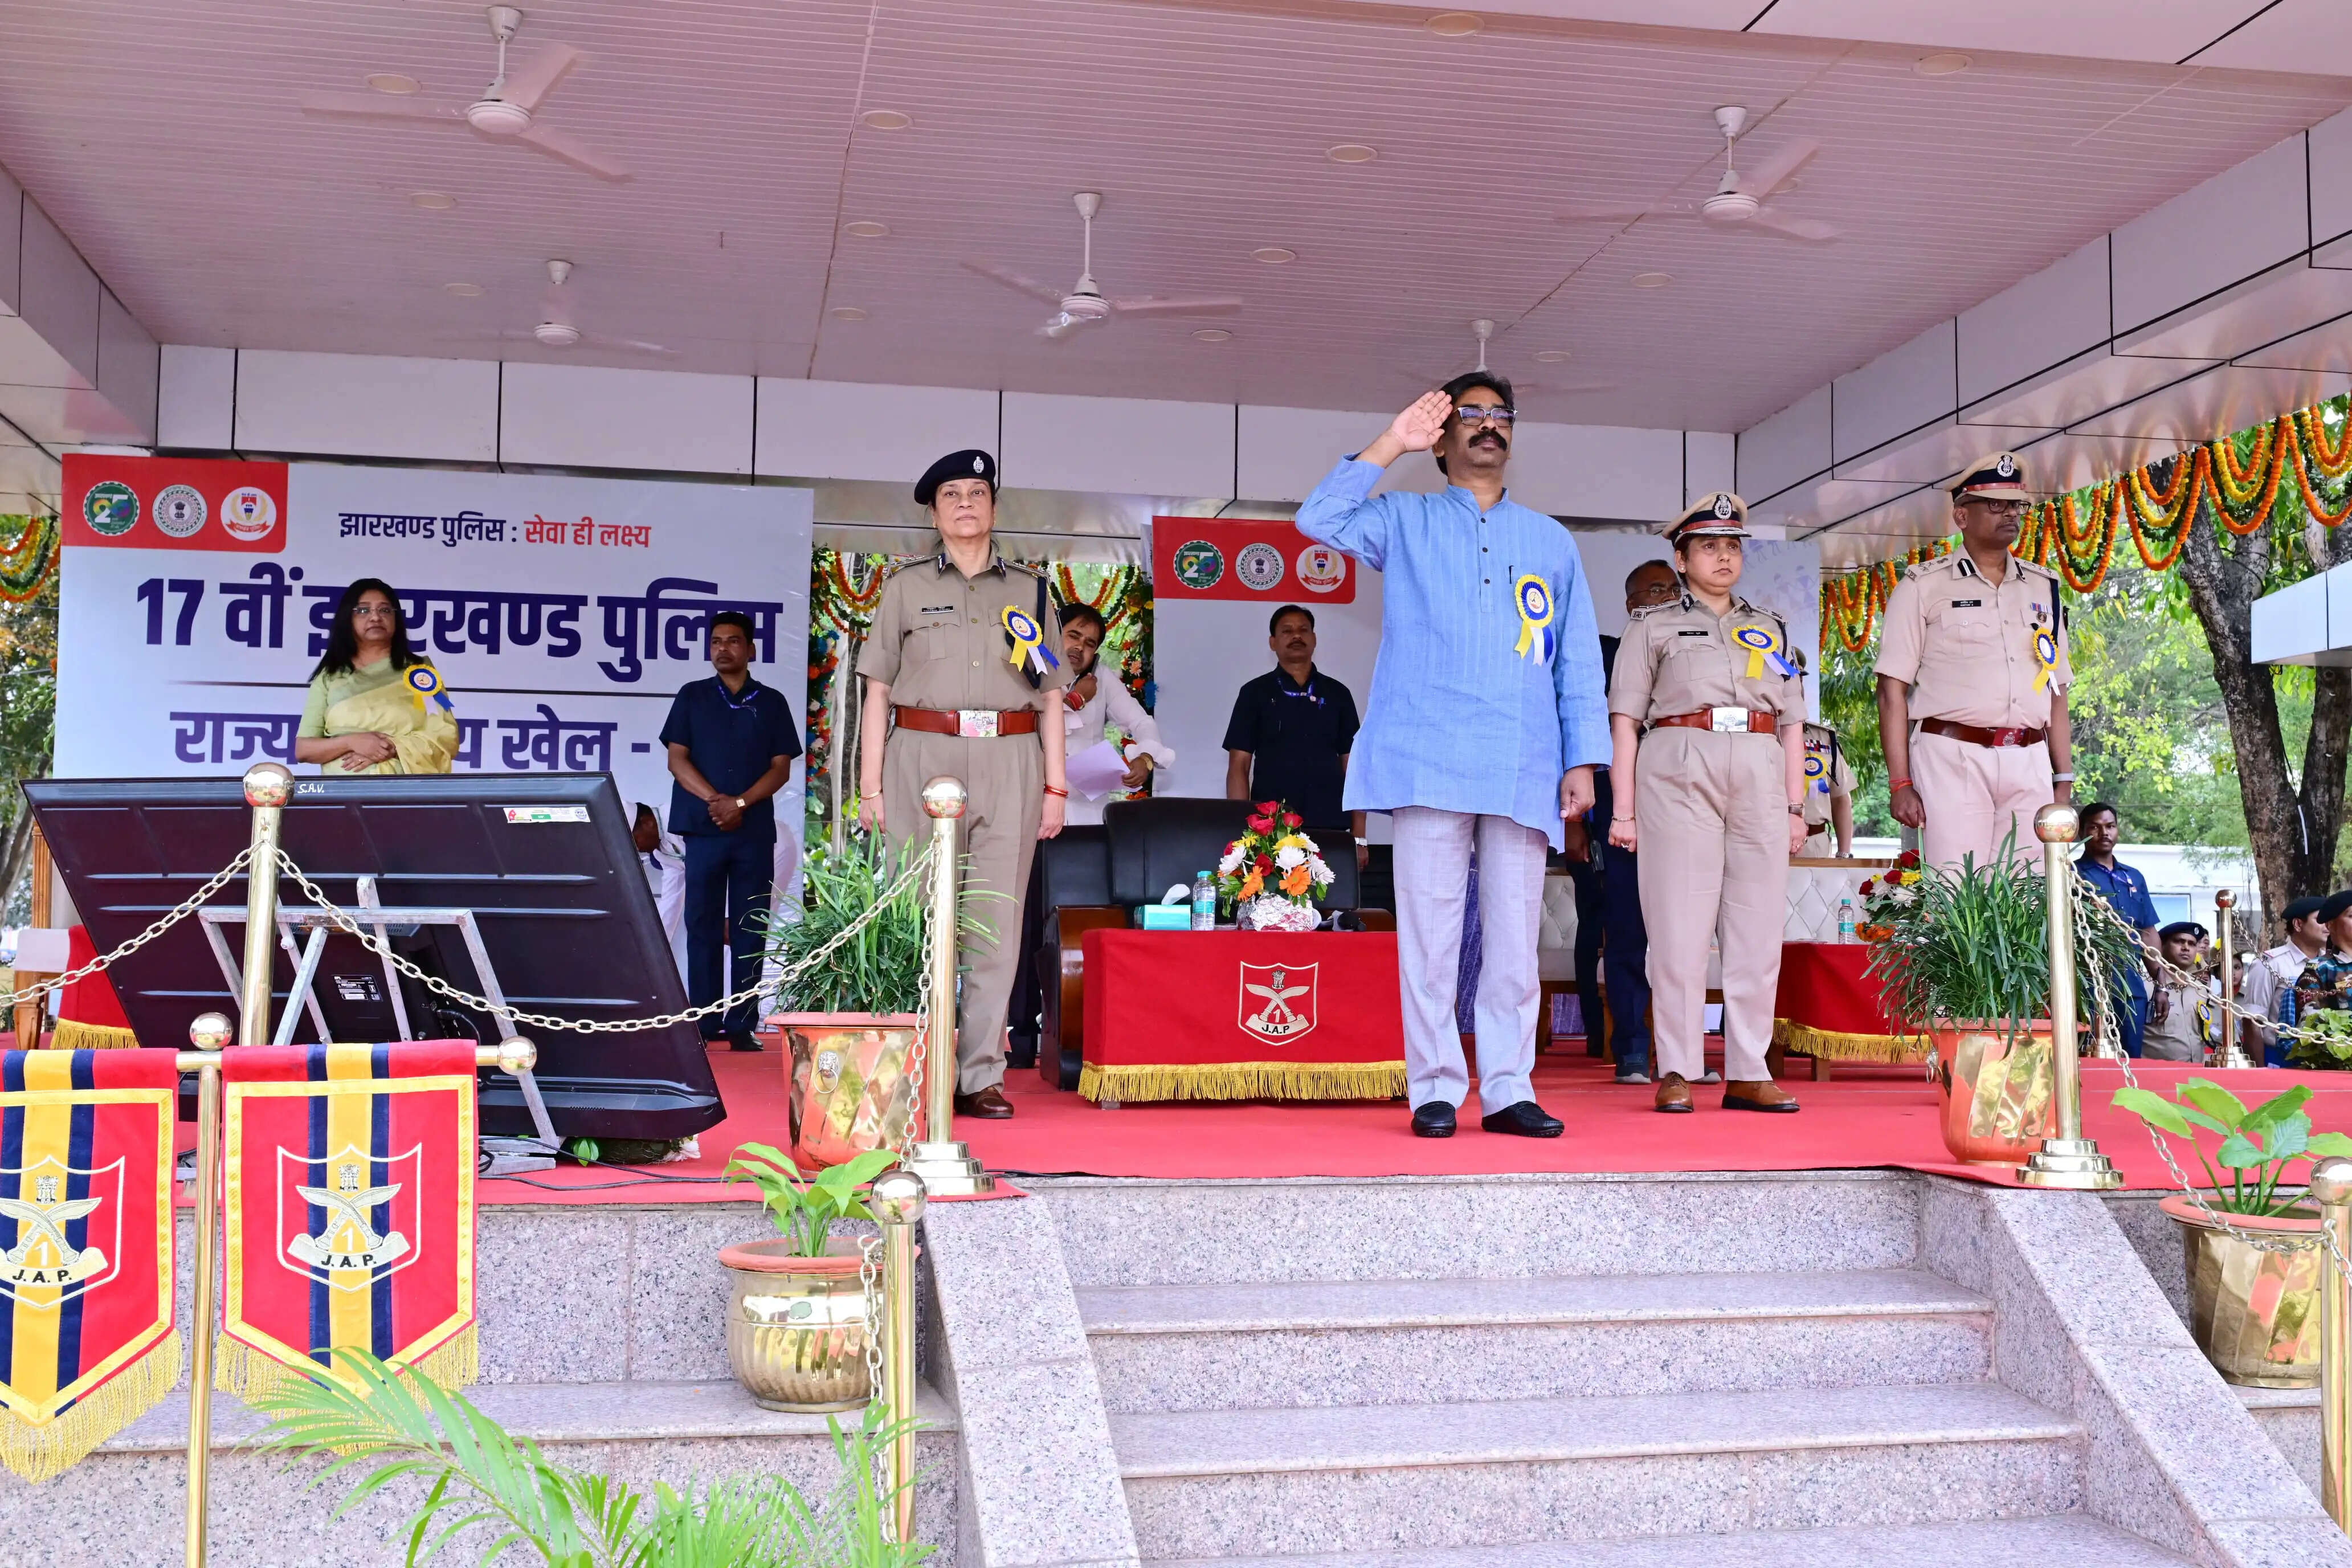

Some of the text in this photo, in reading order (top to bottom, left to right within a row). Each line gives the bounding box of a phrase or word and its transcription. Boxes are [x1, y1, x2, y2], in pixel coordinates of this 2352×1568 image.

[338, 513, 437, 539] झारखण्ड
[441, 511, 507, 547] पुलिस
[524, 514, 568, 544] सेवा
[571, 516, 595, 545] ही
[598, 524, 652, 548] लक्ष्य
[137, 578, 204, 646] 17
[220, 562, 304, 648] वीं
[497, 704, 618, 771] खेल
[1273, 1008, 1281, 1023] 1
[35, 1242, 48, 1267] 1
[341, 1227, 353, 1251] 1
